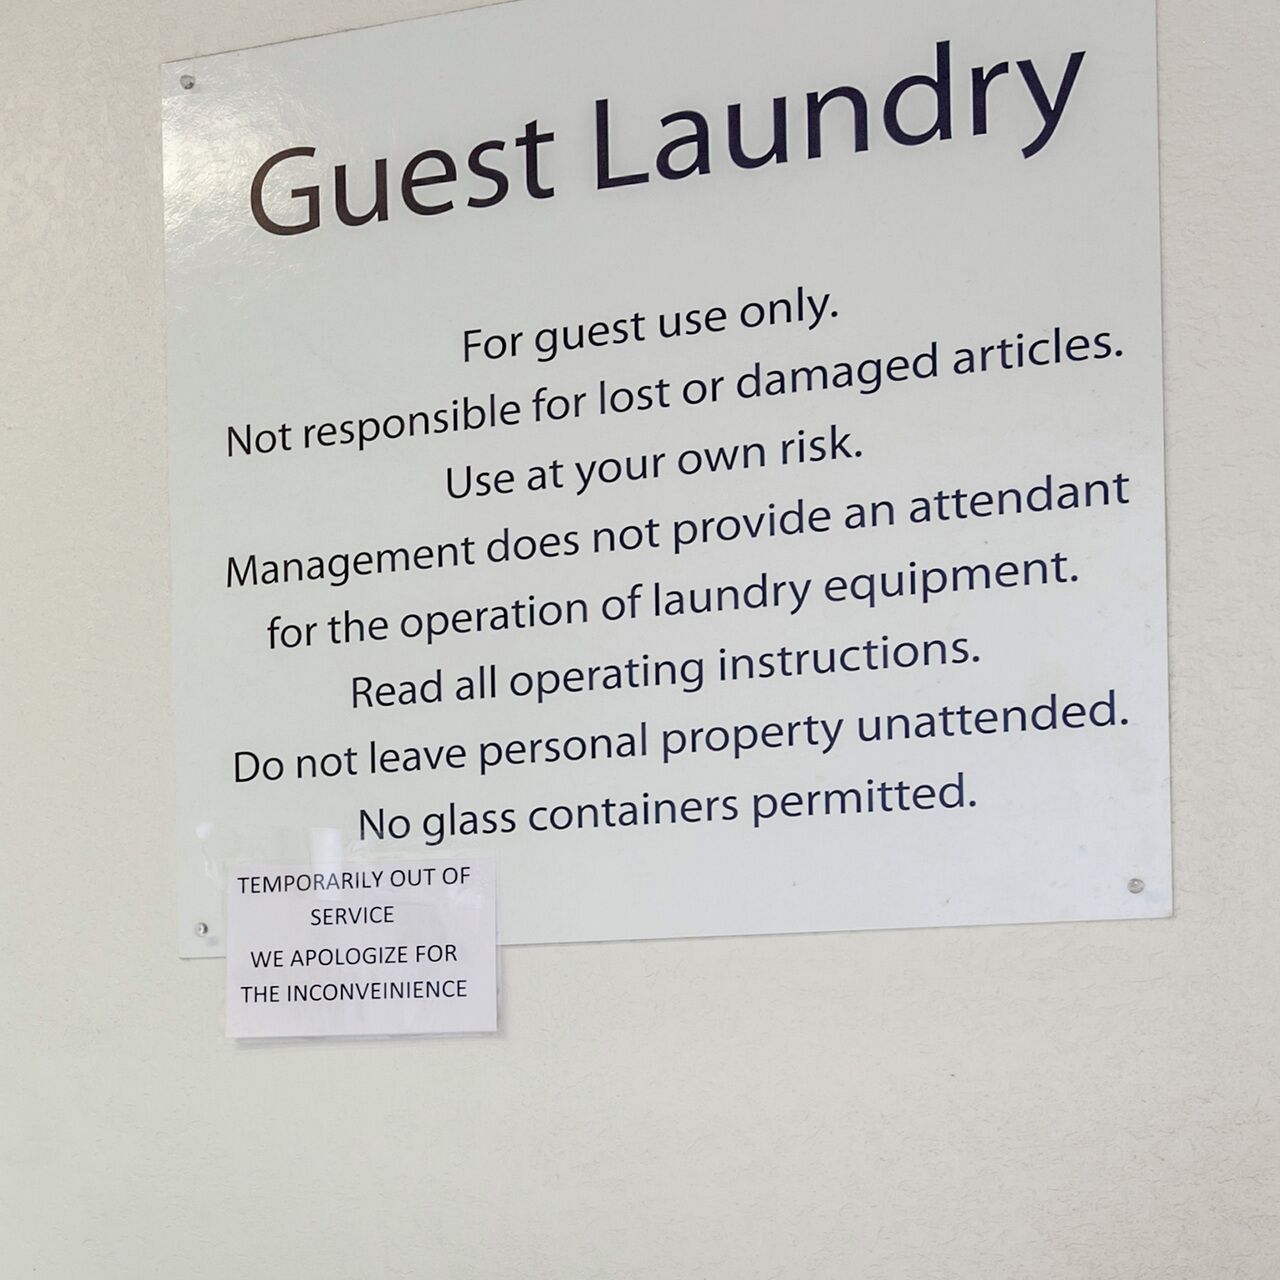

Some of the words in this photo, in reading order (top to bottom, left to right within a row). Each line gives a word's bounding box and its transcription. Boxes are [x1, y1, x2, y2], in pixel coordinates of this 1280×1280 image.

[249, 119, 555, 237] Guest
[594, 39, 1087, 191] Laundry
[463, 328, 524, 363] For
[534, 312, 646, 363] guest
[658, 306, 728, 339] use
[739, 285, 839, 331] only.
[227, 423, 293, 458] Not
[303, 392, 521, 452] responsible
[531, 386, 587, 423] for
[599, 378, 671, 415] lost
[682, 376, 725, 405] or
[736, 340, 938, 399] damaged
[952, 326, 1124, 375] articles.
[446, 464, 515, 500] Use
[526, 459, 565, 492] at
[574, 452, 666, 497] your
[677, 442, 766, 476] own
[781, 423, 863, 466] risk.
[226, 536, 476, 589] Management
[486, 527, 580, 563] does
[593, 518, 661, 554] not
[673, 498, 832, 555] provide
[844, 500, 895, 530] an
[909, 472, 1130, 524] attendant
[266, 615, 318, 650] for
[326, 609, 389, 645] the
[400, 594, 589, 646] operation
[601, 582, 644, 621] of
[653, 572, 813, 617] laundry
[824, 551, 1079, 609] equipment.
[352, 668, 443, 709] Read
[455, 664, 497, 702] all
[509, 653, 704, 705] operating
[719, 634, 981, 682] instructions.
[234, 750, 285, 783] Do
[296, 747, 358, 779] not
[369, 740, 467, 774] leave
[479, 721, 647, 776] personal
[662, 715, 845, 764] property
[857, 688, 1129, 743] unattended.
[359, 807, 411, 841] No
[422, 801, 517, 847] glass
[528, 791, 739, 832] containers
[752, 771, 977, 829] permitted.
[236, 870, 384, 895] TEMPORARILY
[389, 867, 437, 888] OUT
[442, 866, 471, 886] OF
[310, 905, 395, 927] SERVICE
[239, 985, 280, 1004] THE
[287, 979, 468, 1003] INCONVEINIENCE
[250, 949, 284, 969] WE
[289, 945, 409, 968] APOLOGIZE
[415, 943, 458, 963] FOR
